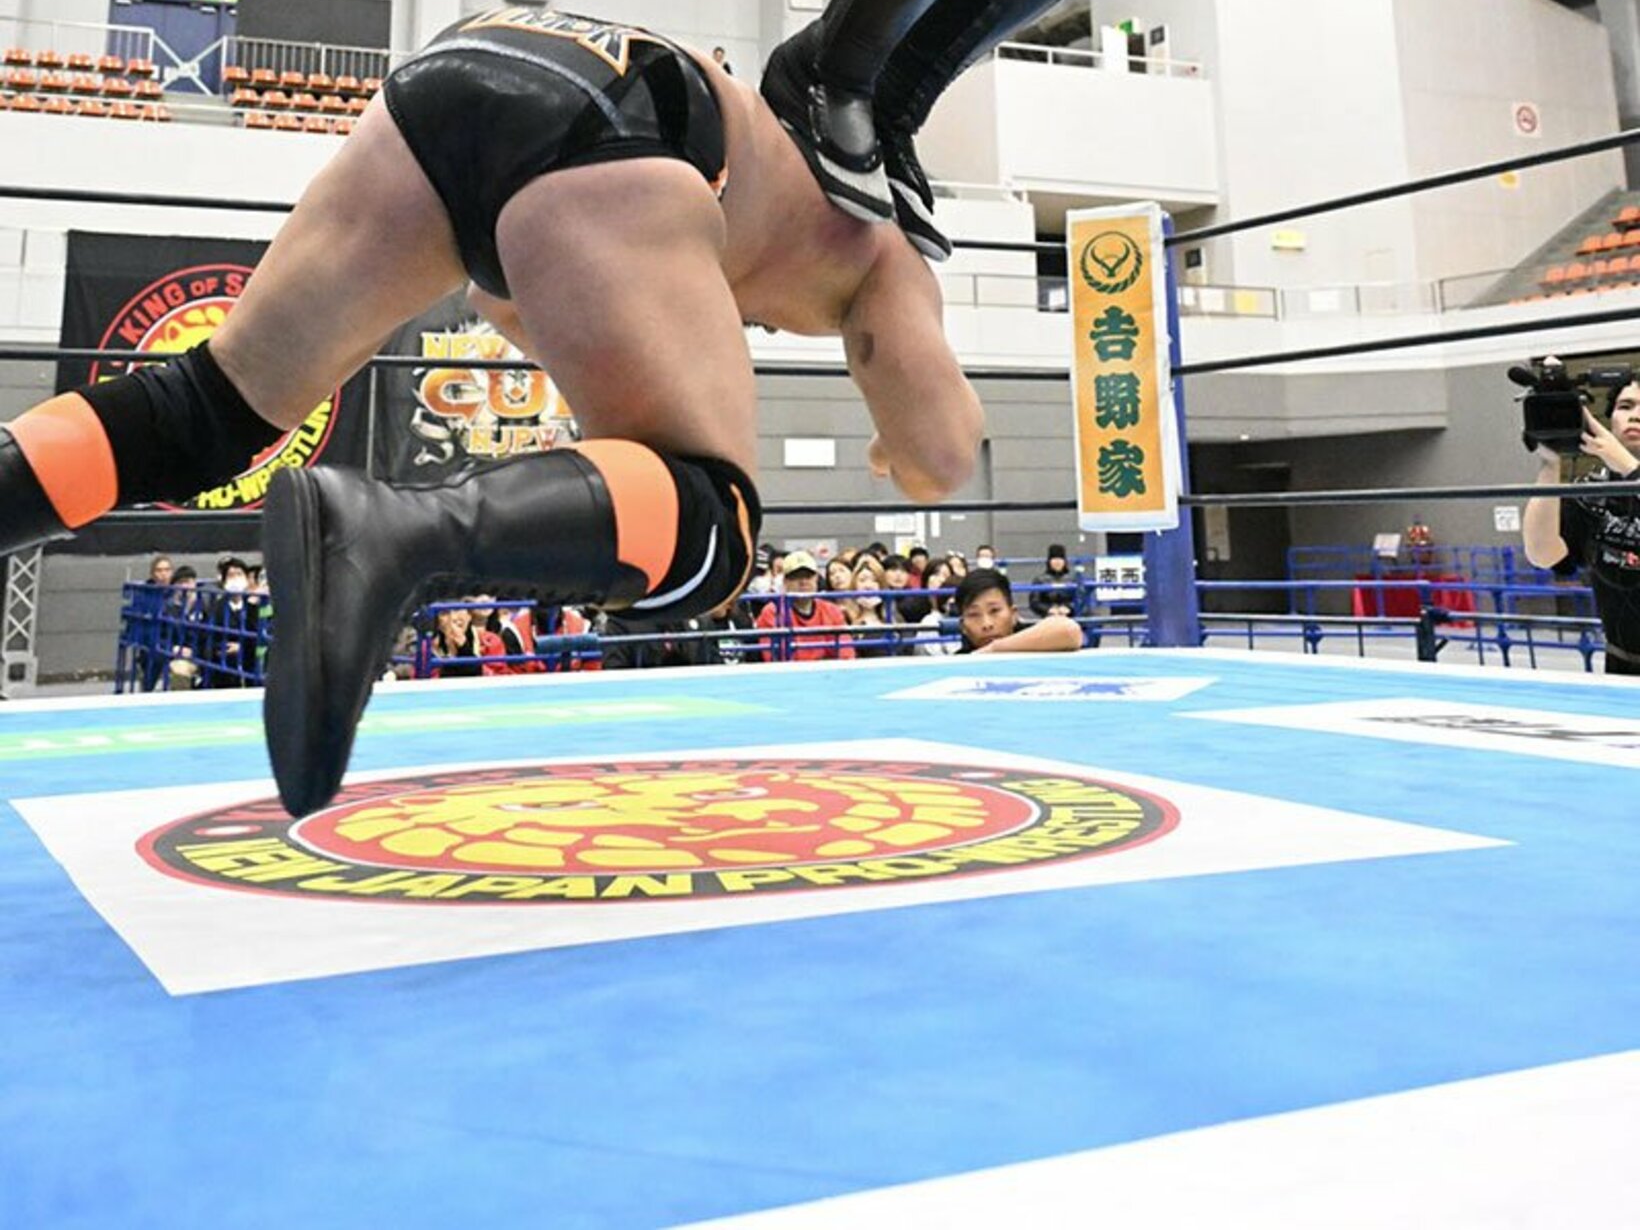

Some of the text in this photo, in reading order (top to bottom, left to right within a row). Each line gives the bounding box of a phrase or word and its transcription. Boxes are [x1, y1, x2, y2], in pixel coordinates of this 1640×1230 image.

[118, 281, 187, 346] KING
[190, 277, 219, 297] OF
[420, 366, 574, 420] CU
[466, 425, 557, 457] NJPW
[176, 778, 1144, 899] NEW JAPAN PRO-WRESTLING
